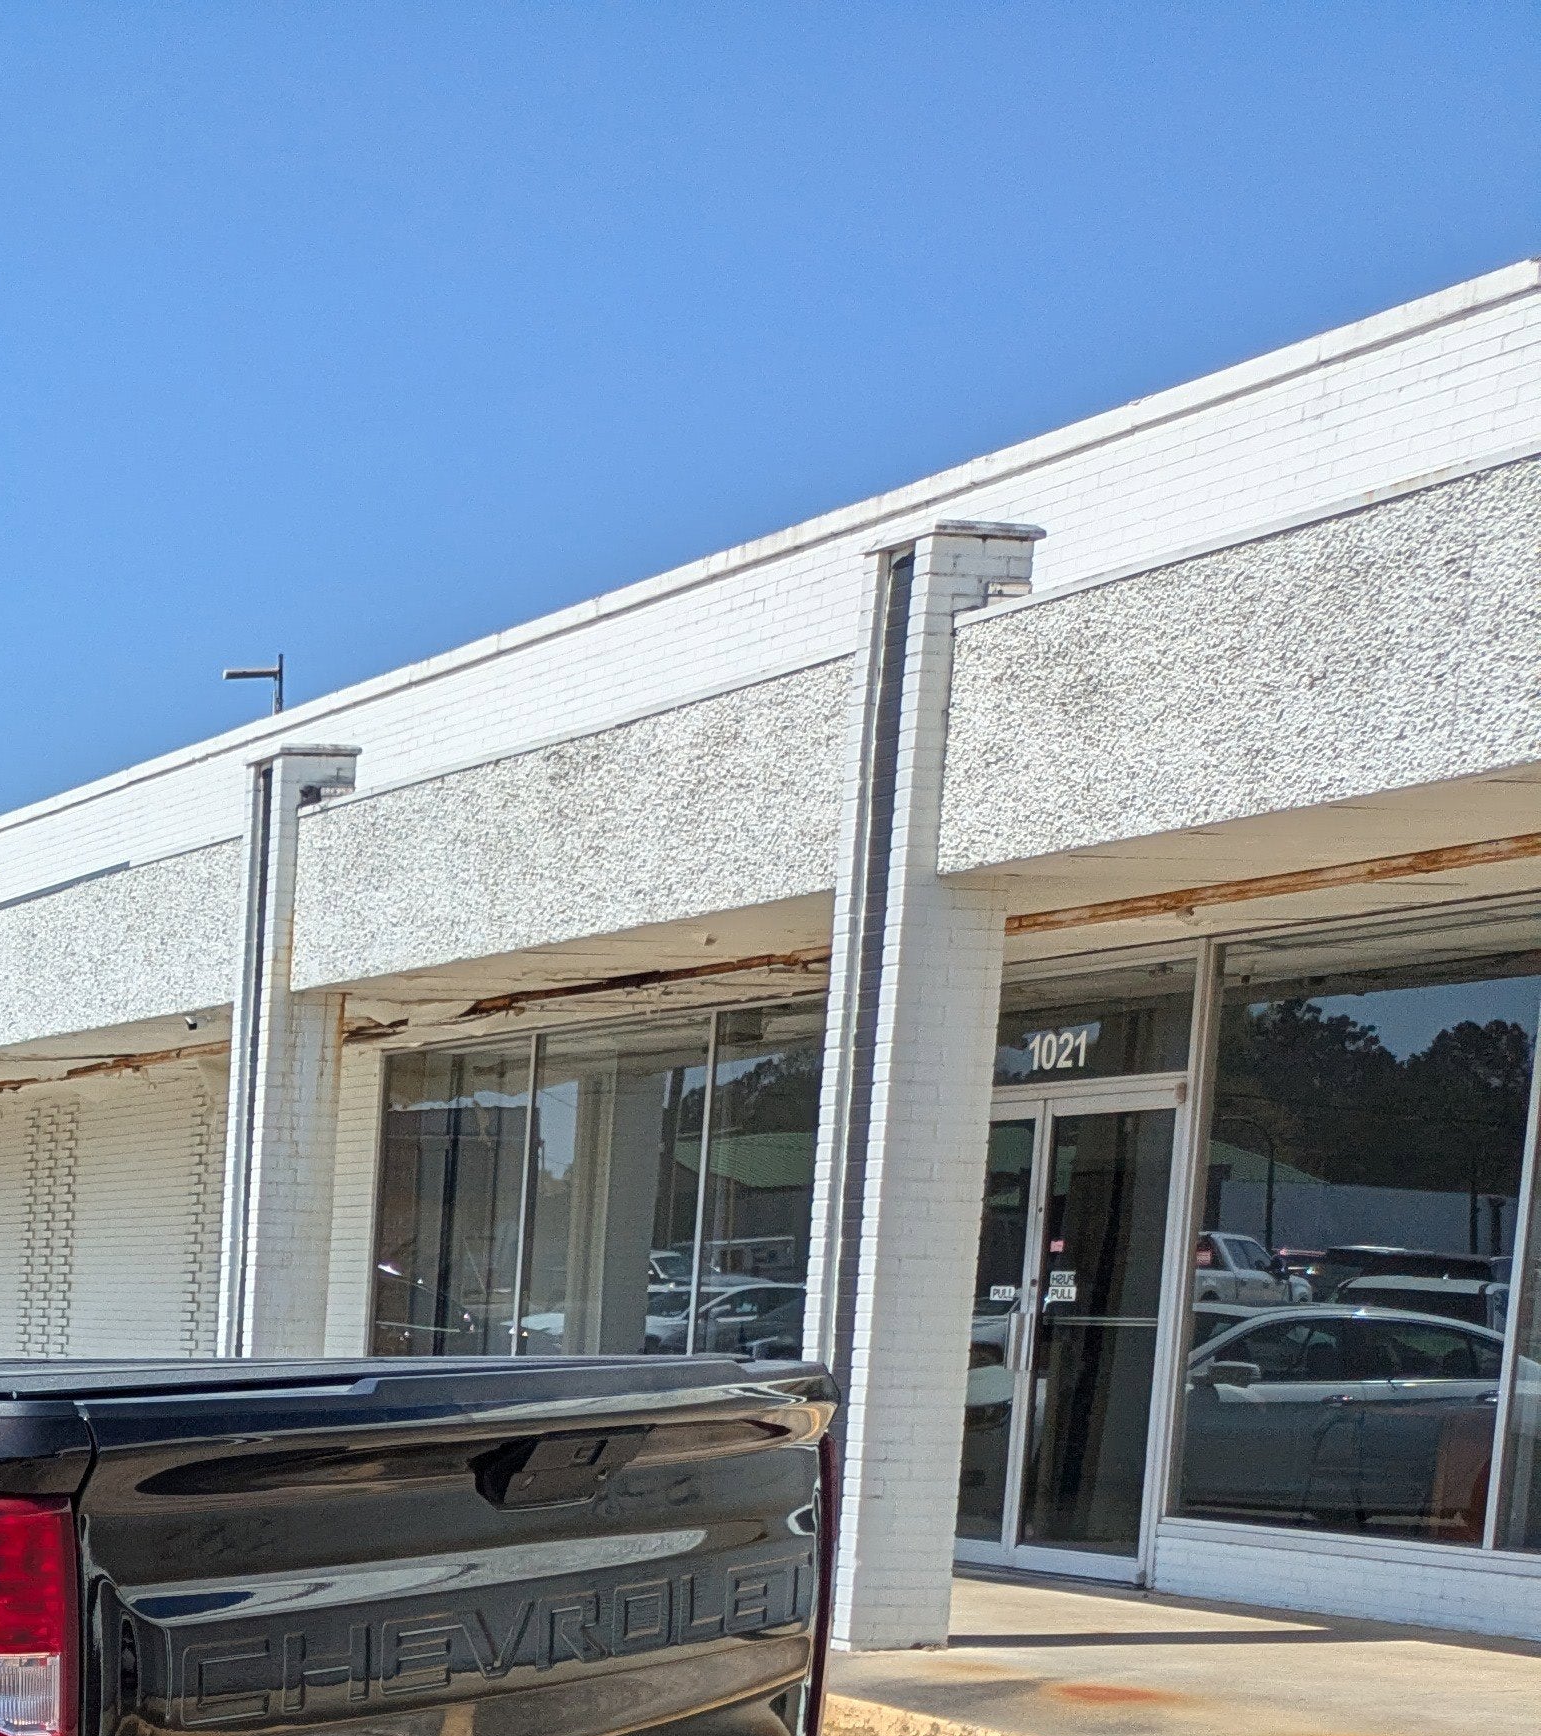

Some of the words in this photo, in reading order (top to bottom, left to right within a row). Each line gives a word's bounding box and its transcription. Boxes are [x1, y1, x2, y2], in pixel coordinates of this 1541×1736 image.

[1029, 1030, 1087, 1071] 1021
[992, 1288, 1014, 1299] PULL
[1049, 1288, 1073, 1300] PULL
[181, 1551, 813, 1728] CHEVROLET
